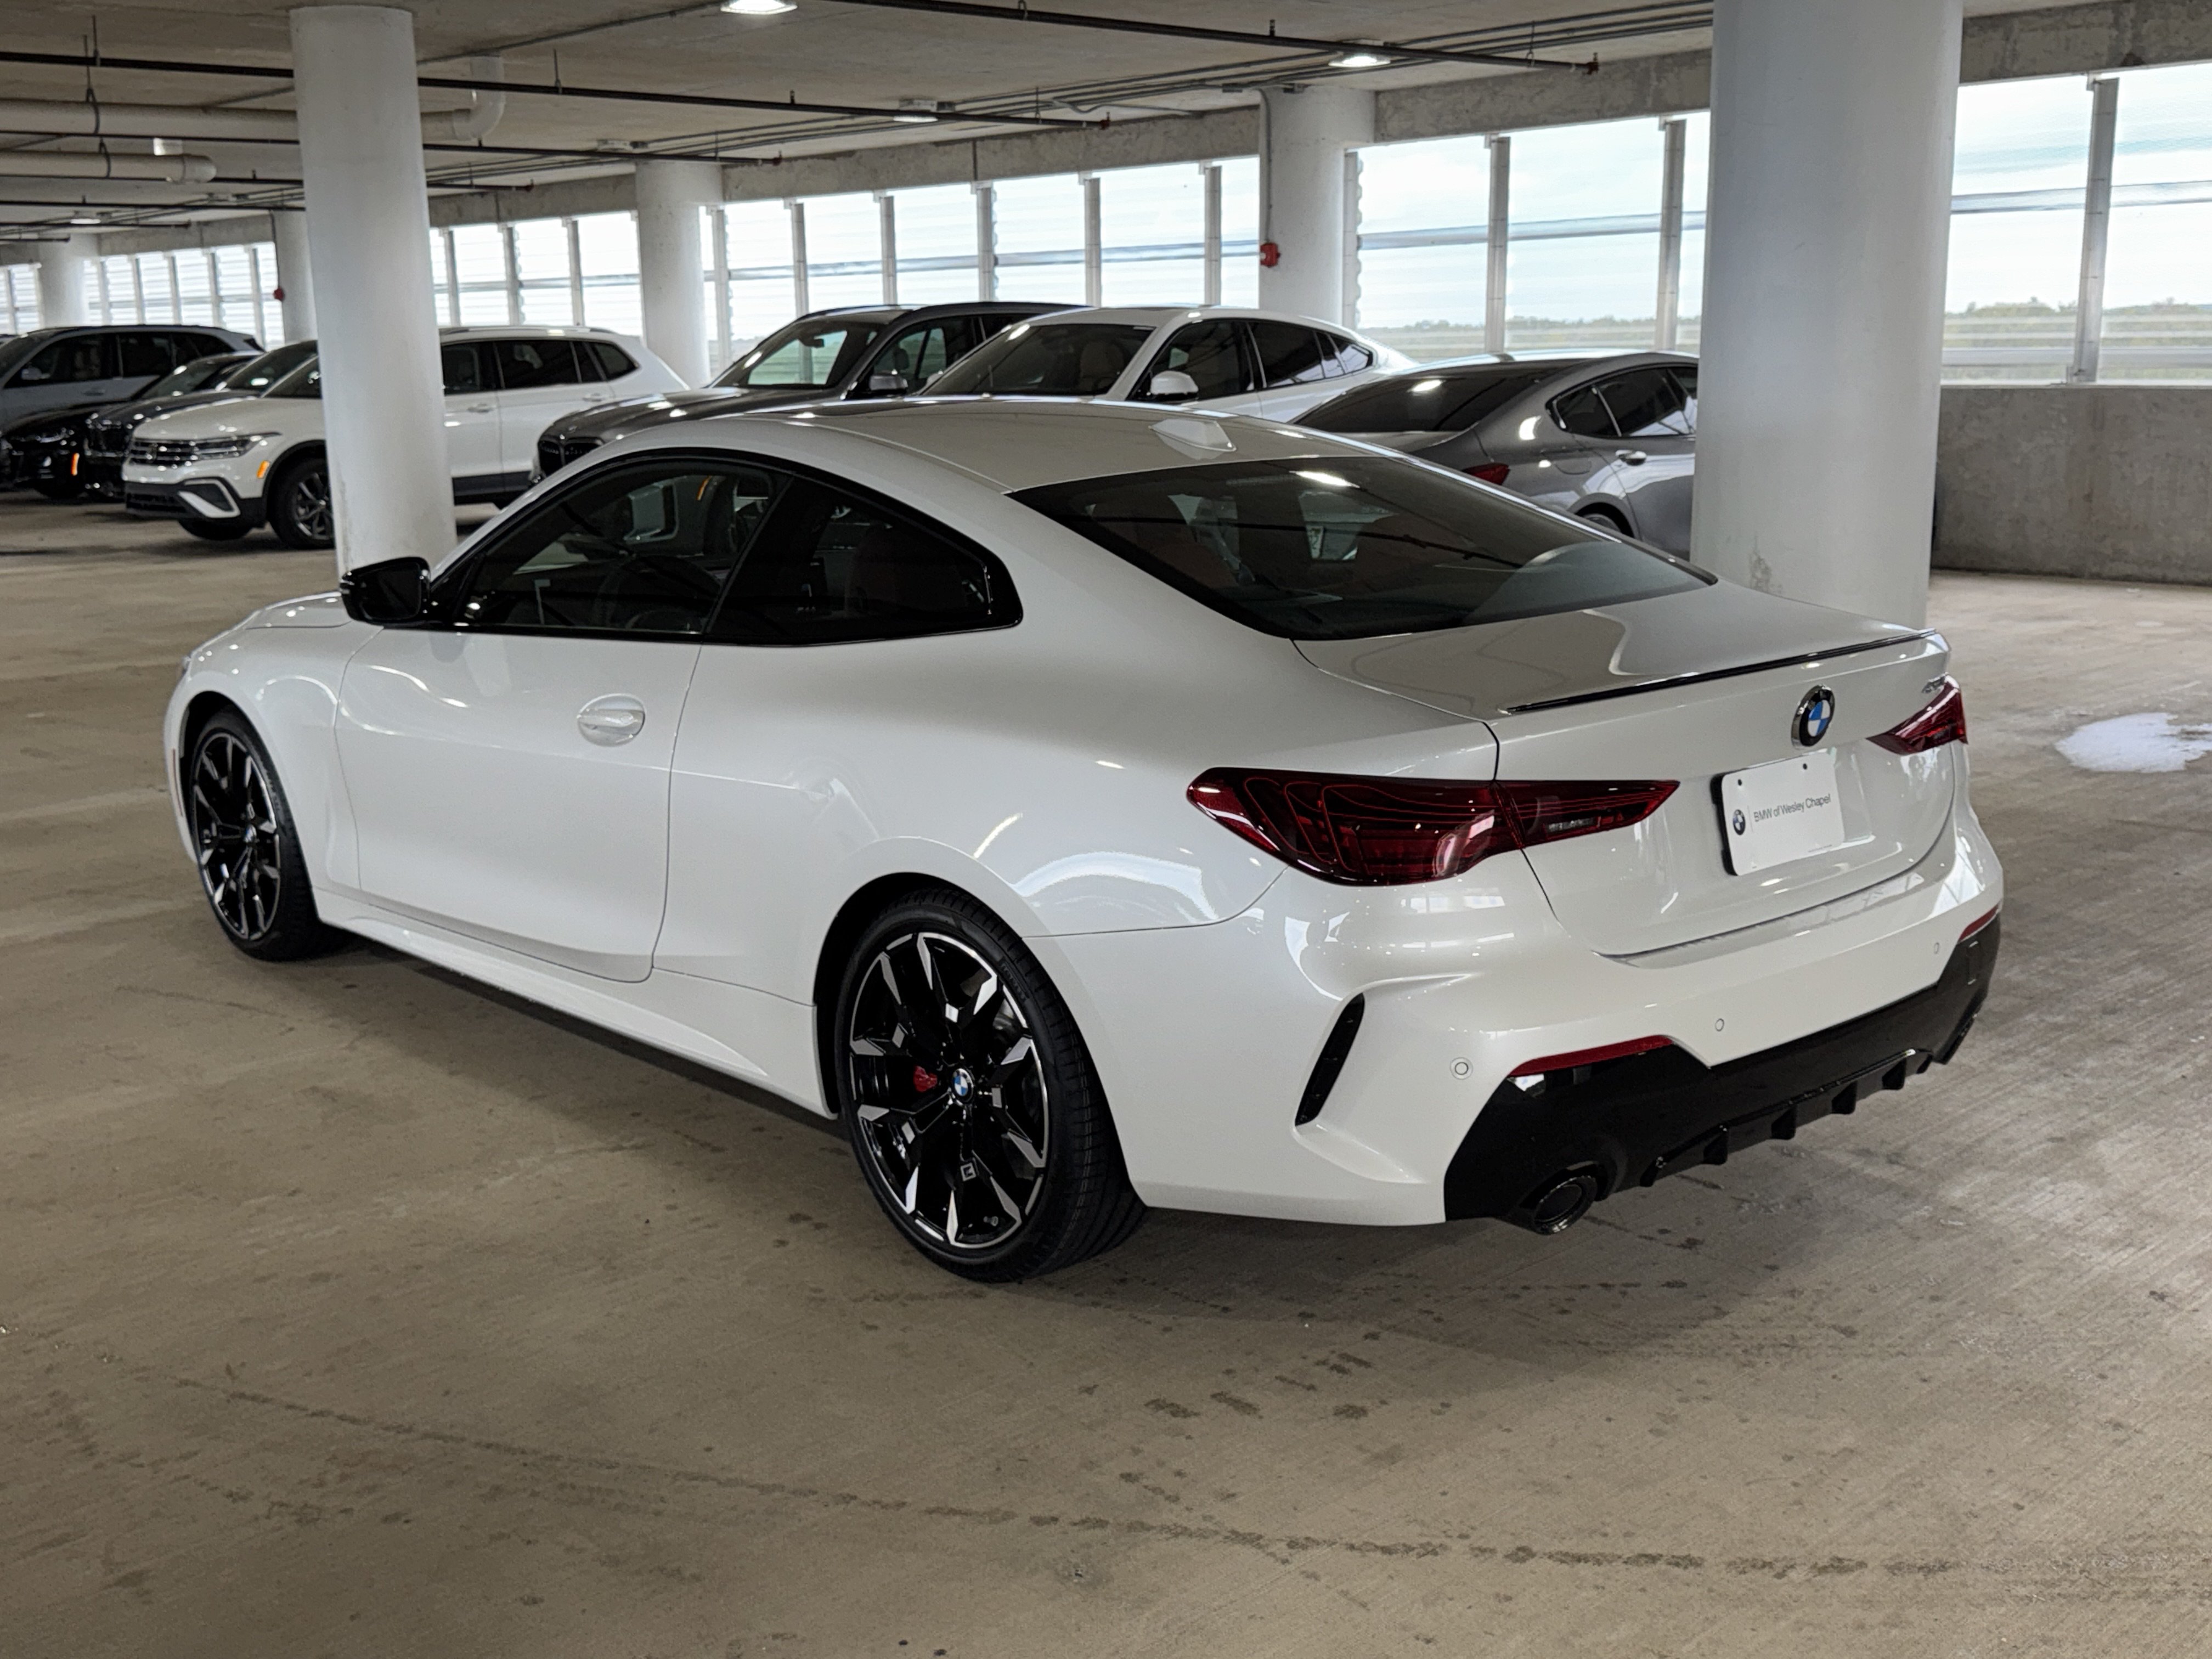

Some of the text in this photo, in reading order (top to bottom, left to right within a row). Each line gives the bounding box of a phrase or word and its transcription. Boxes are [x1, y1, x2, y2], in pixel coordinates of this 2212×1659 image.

[1753, 808, 1773, 822] BMW
[1773, 805, 1780, 817] of
[1780, 802, 1804, 815] Wesley
[1805, 793, 1831, 808] Chapel
